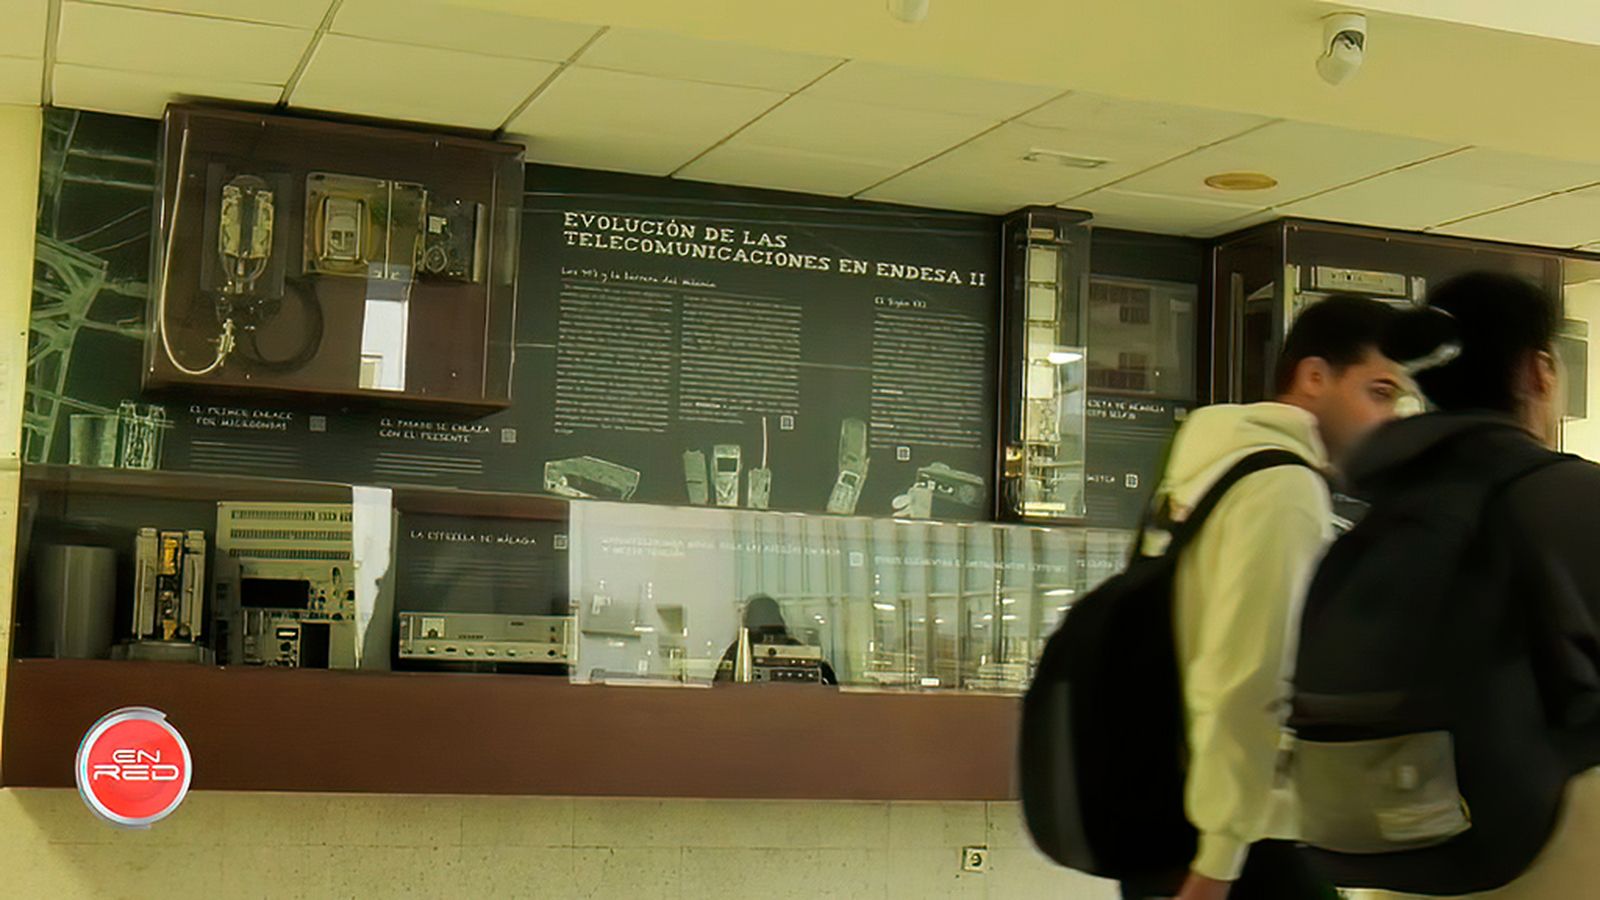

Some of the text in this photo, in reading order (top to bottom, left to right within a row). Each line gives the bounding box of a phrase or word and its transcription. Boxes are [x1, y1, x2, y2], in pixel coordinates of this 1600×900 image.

[563, 211, 788, 249] EVOLUCIÓN DE LAS
[563, 230, 987, 287] TELECOMUNICACIONES EN ENDESA II
